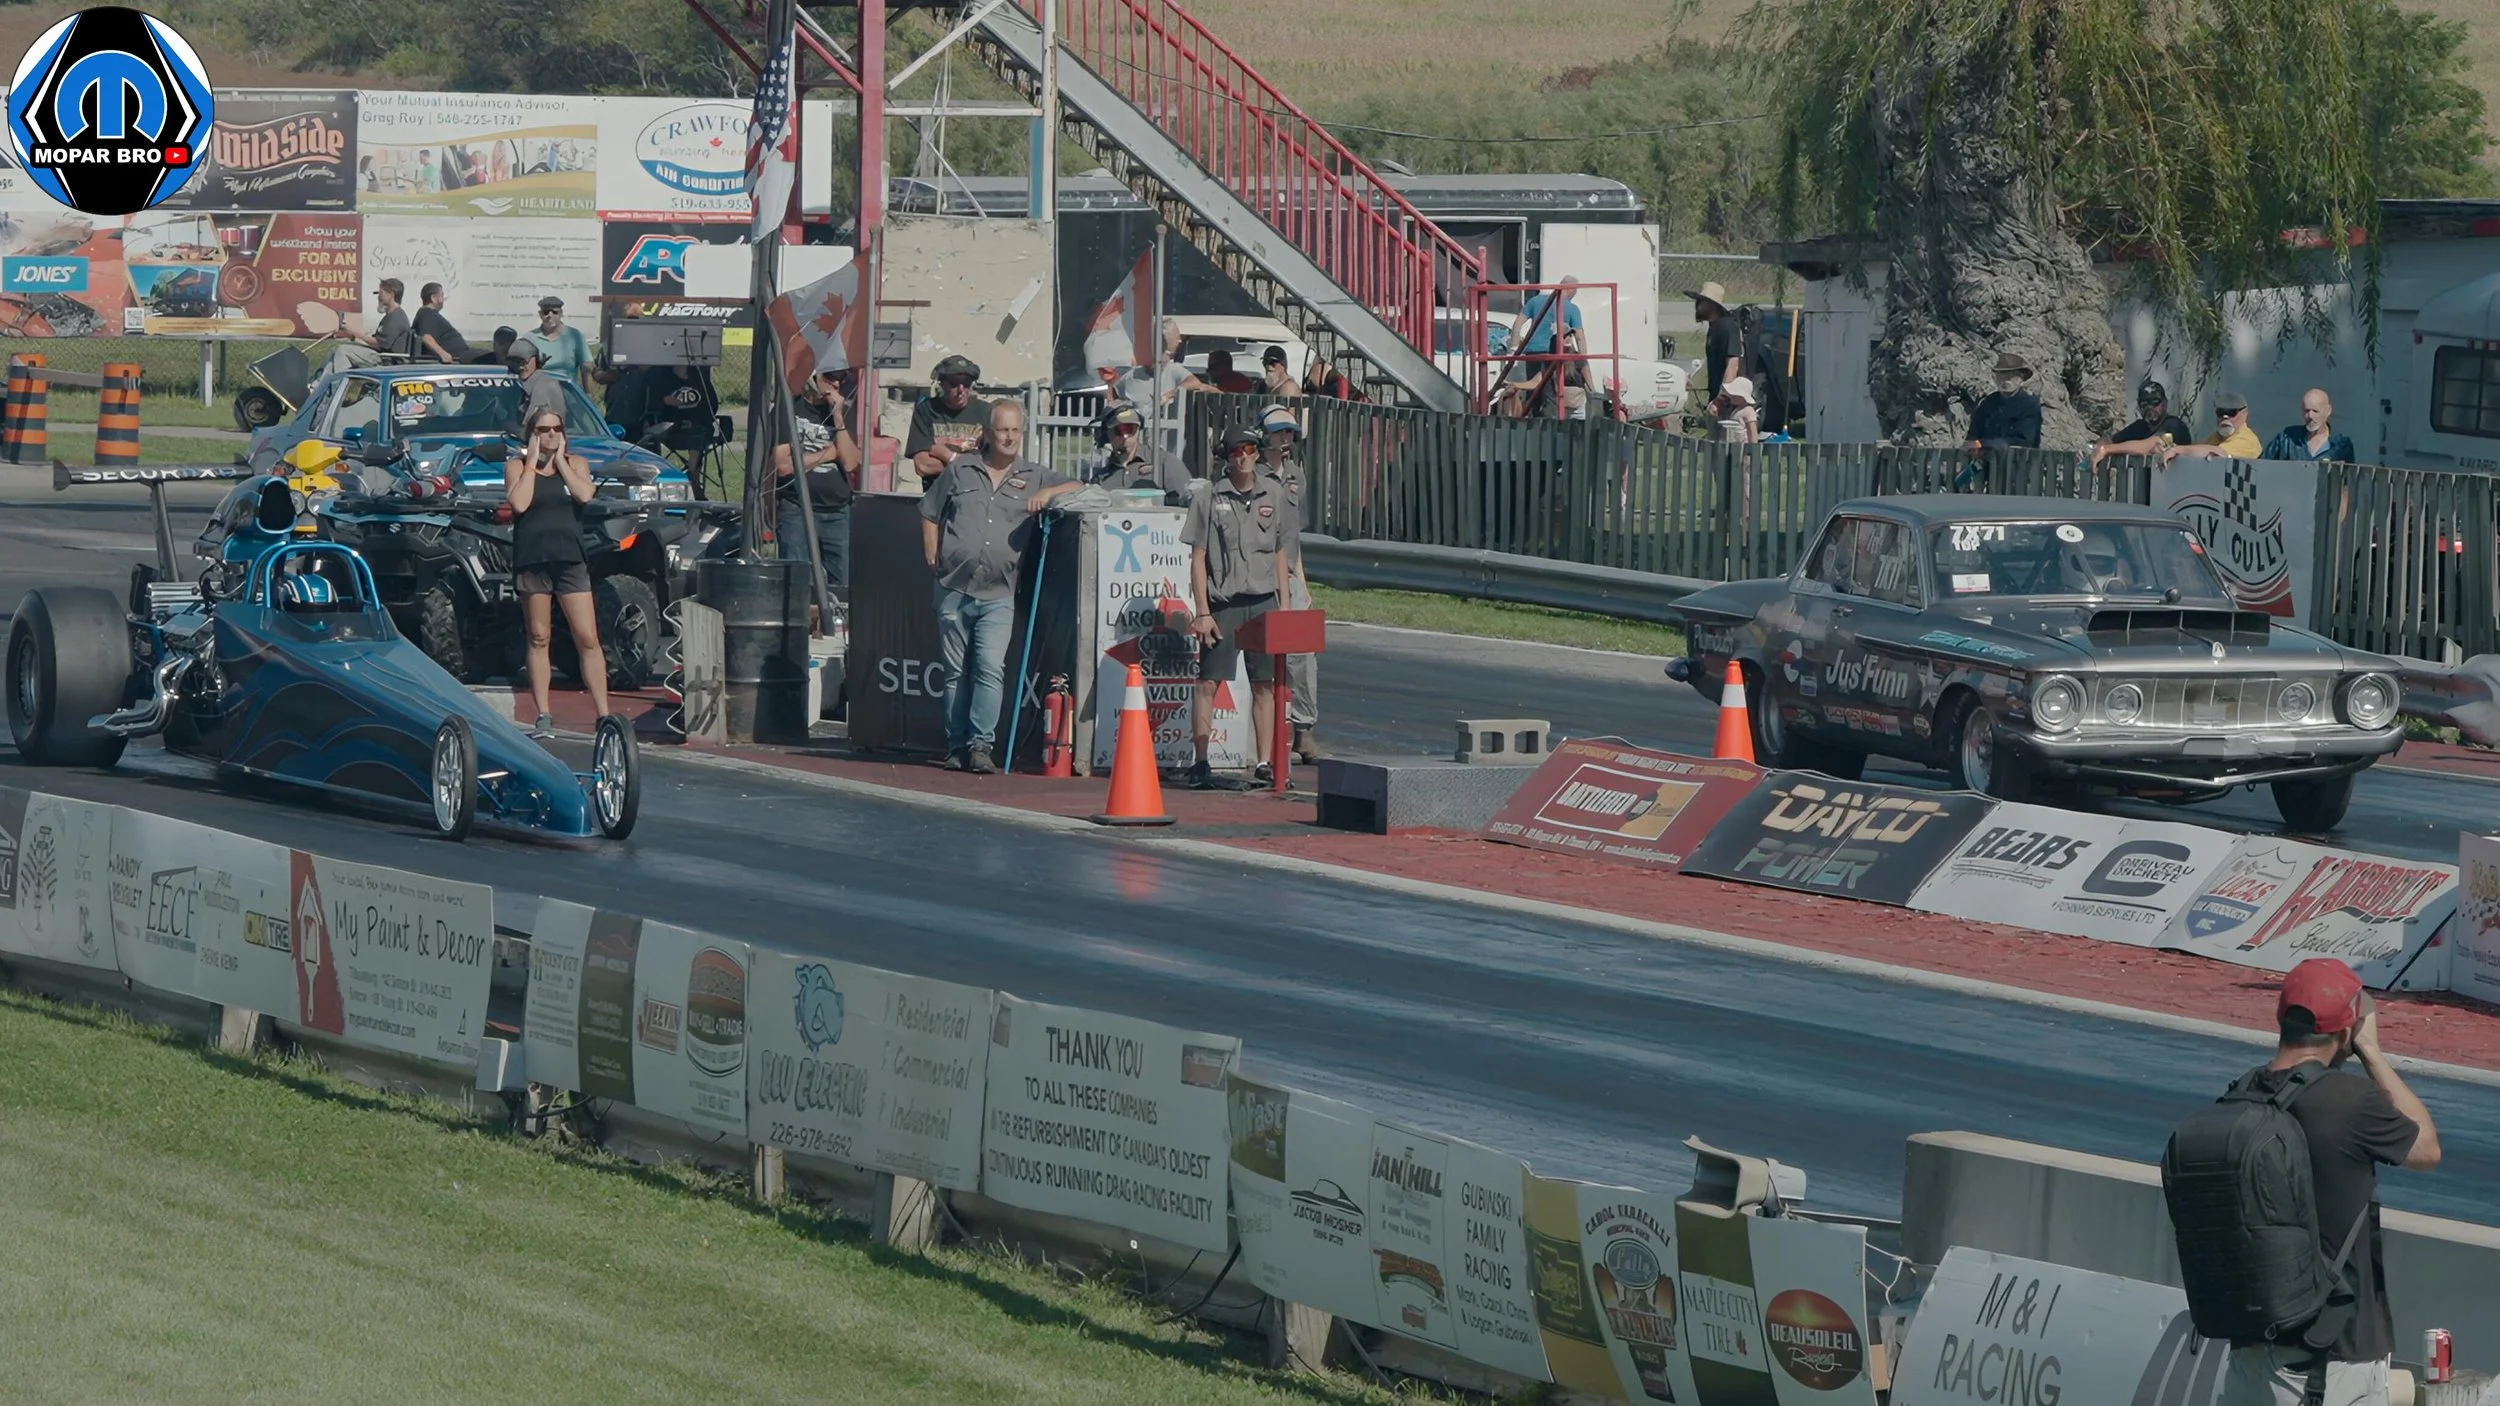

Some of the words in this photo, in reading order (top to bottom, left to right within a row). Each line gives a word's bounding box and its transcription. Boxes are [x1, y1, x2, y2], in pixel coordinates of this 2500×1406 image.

[397, 95, 441, 108] Mutual
[445, 97, 511, 109] Insurance
[13, 266, 77, 283] JONES
[271, 269, 357, 283] EXCLUSIVE
[299, 252, 330, 266] FOR
[333, 252, 357, 266] AN
[317, 287, 357, 301] DEAL
[1151, 553, 1183, 567] Print
[2231, 521, 2284, 573] CULLY
[1110, 582, 1181, 599] DIGITAL
[1760, 784, 1950, 843] DAYCO
[1961, 827, 2093, 870] BEARS
[335, 900, 358, 957] My
[366, 904, 410, 952] Paint
[418, 914, 430, 956] &
[436, 919, 485, 967] Decor
[896, 992, 973, 1041] Residential
[894, 1046, 973, 1090] Commercial
[1046, 1026, 1111, 1072] THANK
[1116, 1037, 1144, 1079] YOU
[890, 1095, 952, 1141] Industrial
[1025, 1076, 1040, 1101] TO
[1043, 1081, 1066, 1106] ALL
[1068, 1084, 1107, 1115] THESE
[1108, 1090, 1158, 1126] COMPANIES
[1013, 1113, 1107, 1154] REFURBISHMENT
[1109, 1131, 1121, 1157] OF
[1123, 1136, 1167, 1170] CANADA'S
[1169, 1147, 1212, 1181] OLDEST
[1046, 1163, 1103, 1196] RUNNING
[1106, 1174, 1131, 1204] DRAG
[1132, 1181, 1167, 1213] RACING
[1169, 1189, 1213, 1223] FACILITY
[1462, 1181, 1512, 1221] GUBINSKI
[1466, 1218, 1507, 1254] FAMILY
[1464, 1252, 1512, 1291] RACING
[1975, 1272, 2018, 1330] M
[2012, 1278, 2040, 1335] &
[1703, 1322, 1733, 1355] TIRE
[1770, 1323, 1857, 1352] BEAUSOLEIL
[1787, 1346, 1842, 1373] Racing
[1933, 1333, 2062, 1406] RACING
